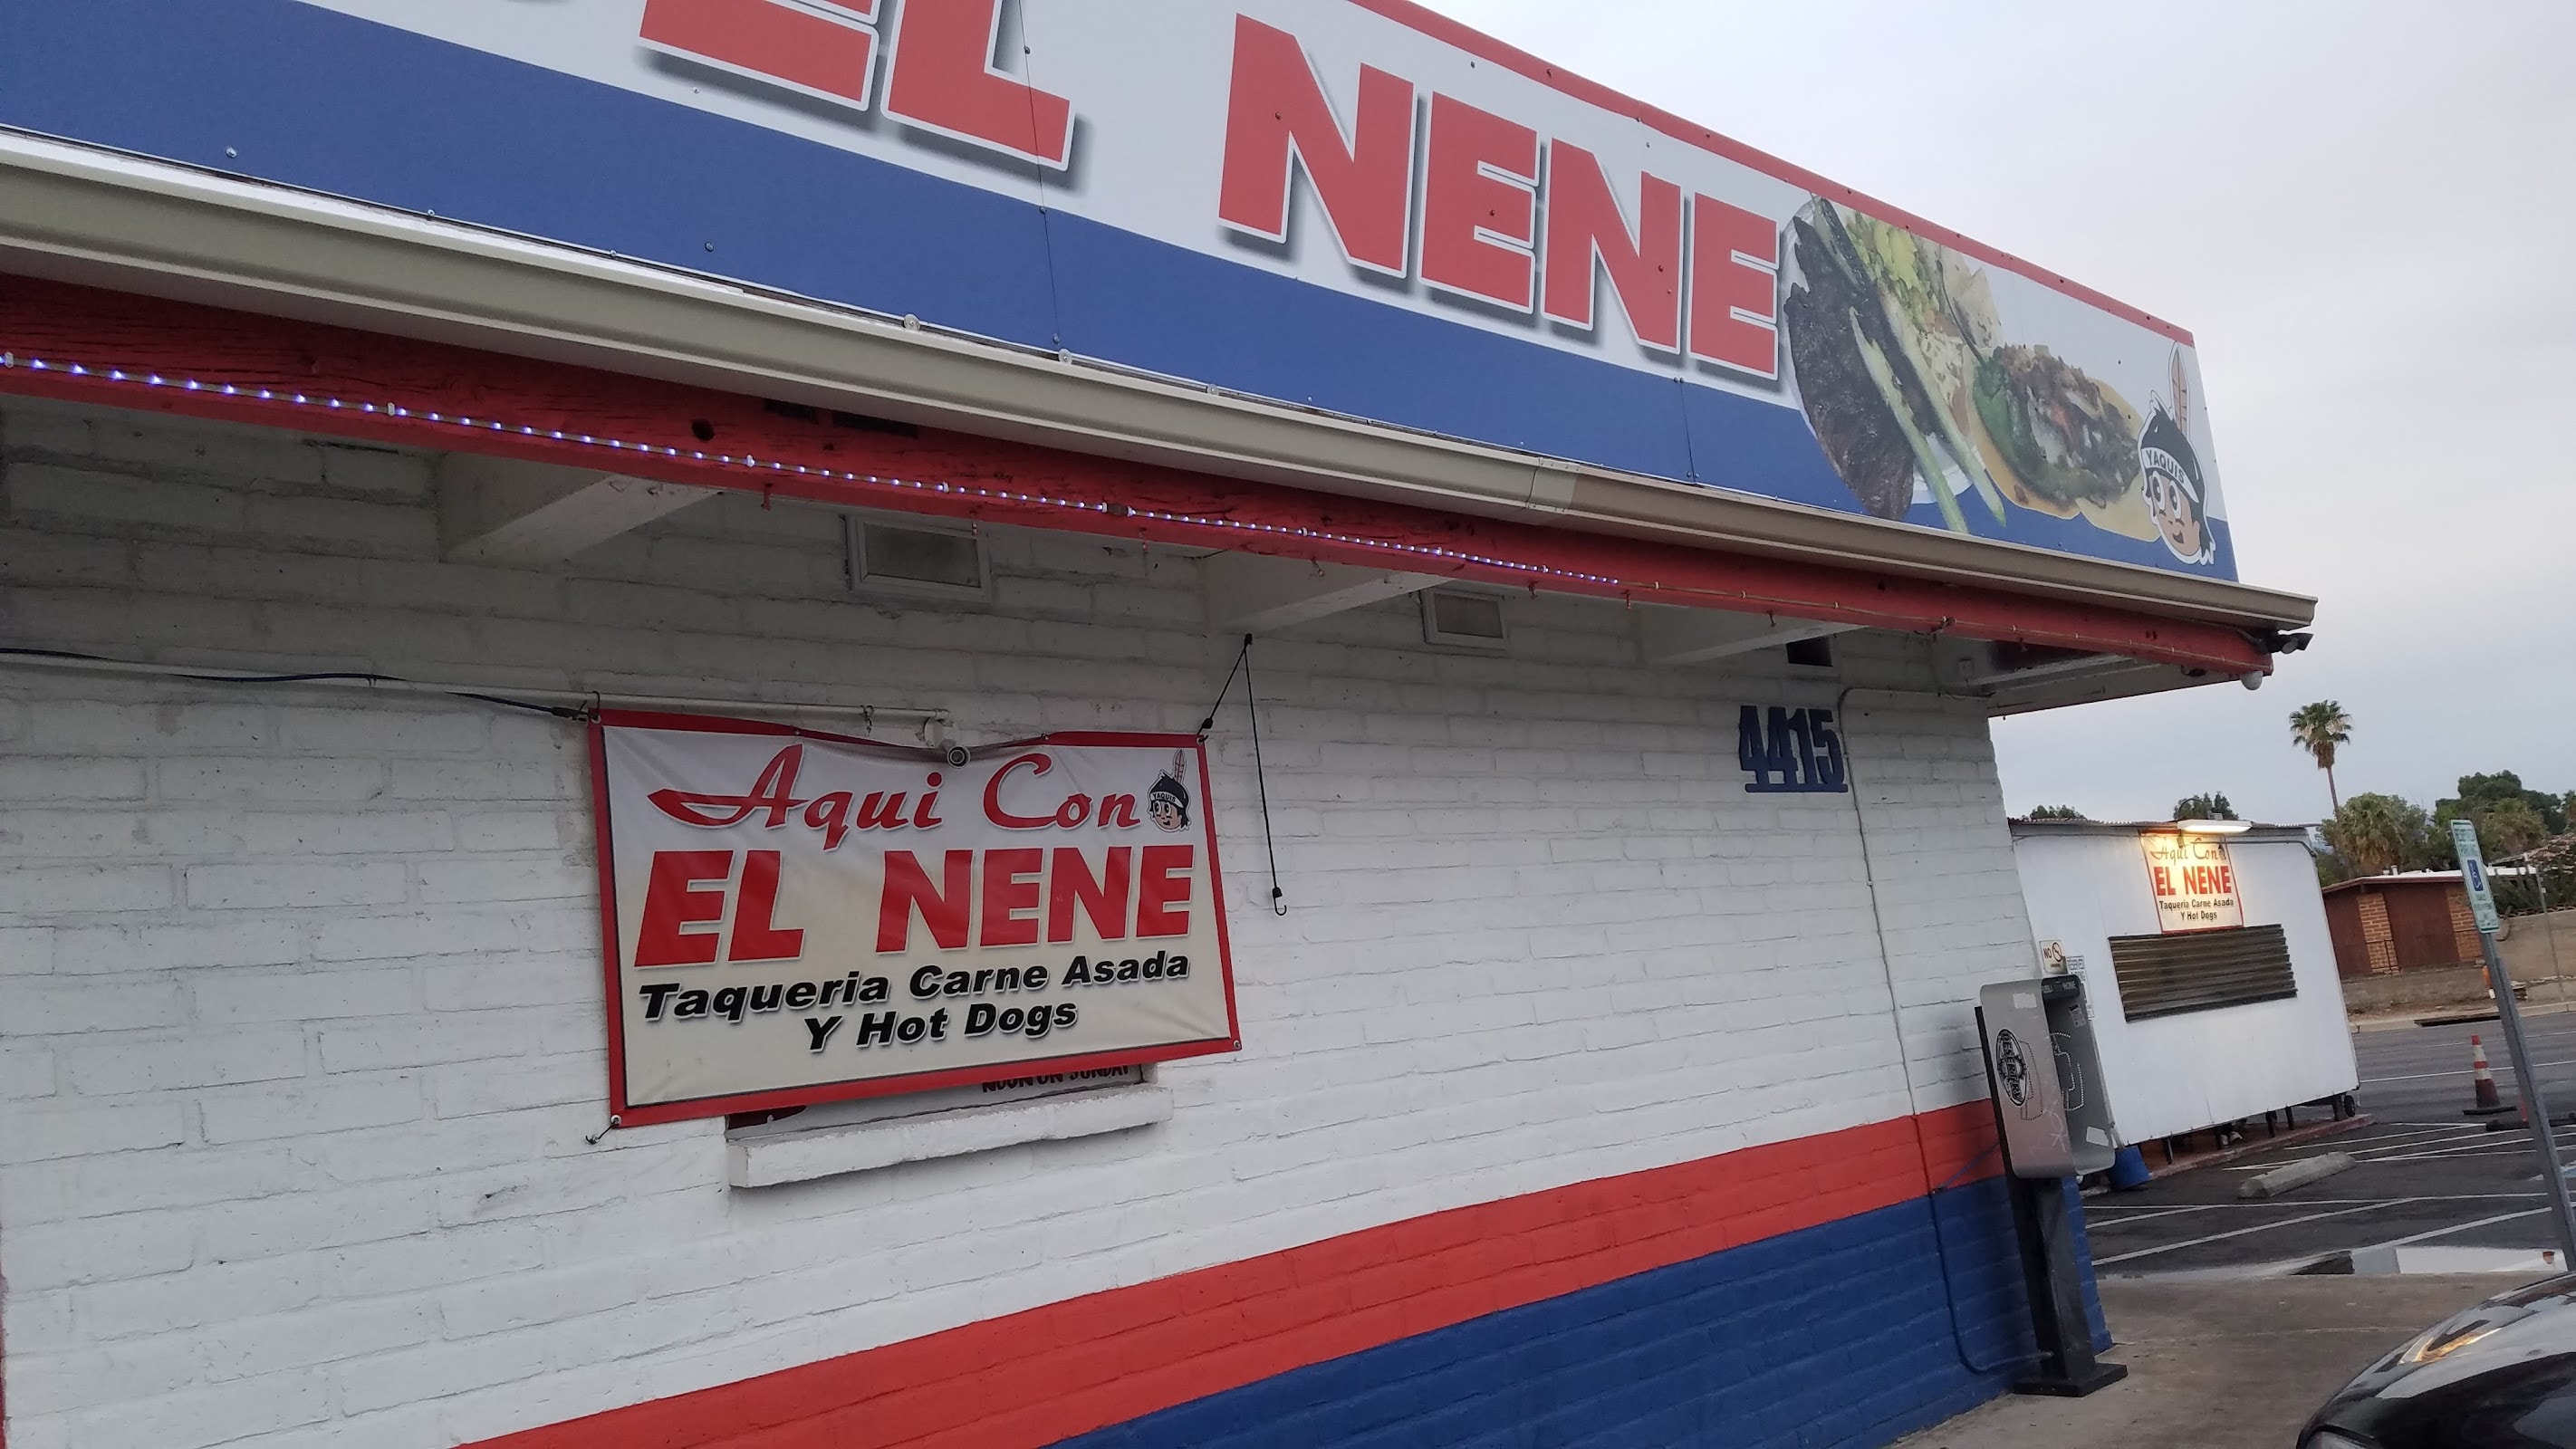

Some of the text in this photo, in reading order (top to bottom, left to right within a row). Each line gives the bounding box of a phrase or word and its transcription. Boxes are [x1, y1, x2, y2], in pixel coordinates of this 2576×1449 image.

[638, 0, 1779, 377] L NENE
[2145, 449, 2185, 485] YAQUIS
[1738, 705, 1845, 786] 4415
[647, 743, 1141, 850] Aqui Con
[1152, 792, 1177, 802] YAQUIS
[2149, 837, 2219, 866] Aqui Con
[2153, 865, 2232, 897] EL NENE
[633, 844, 1195, 968] EL NENE
[2158, 897, 2235, 911] Taqueria Carne Asada
[2180, 910, 2217, 921] Y Hot Dogs
[638, 949, 1190, 1021] Taqueria Carne Asada
[804, 1000, 1078, 1051] Y Hot Dogs
